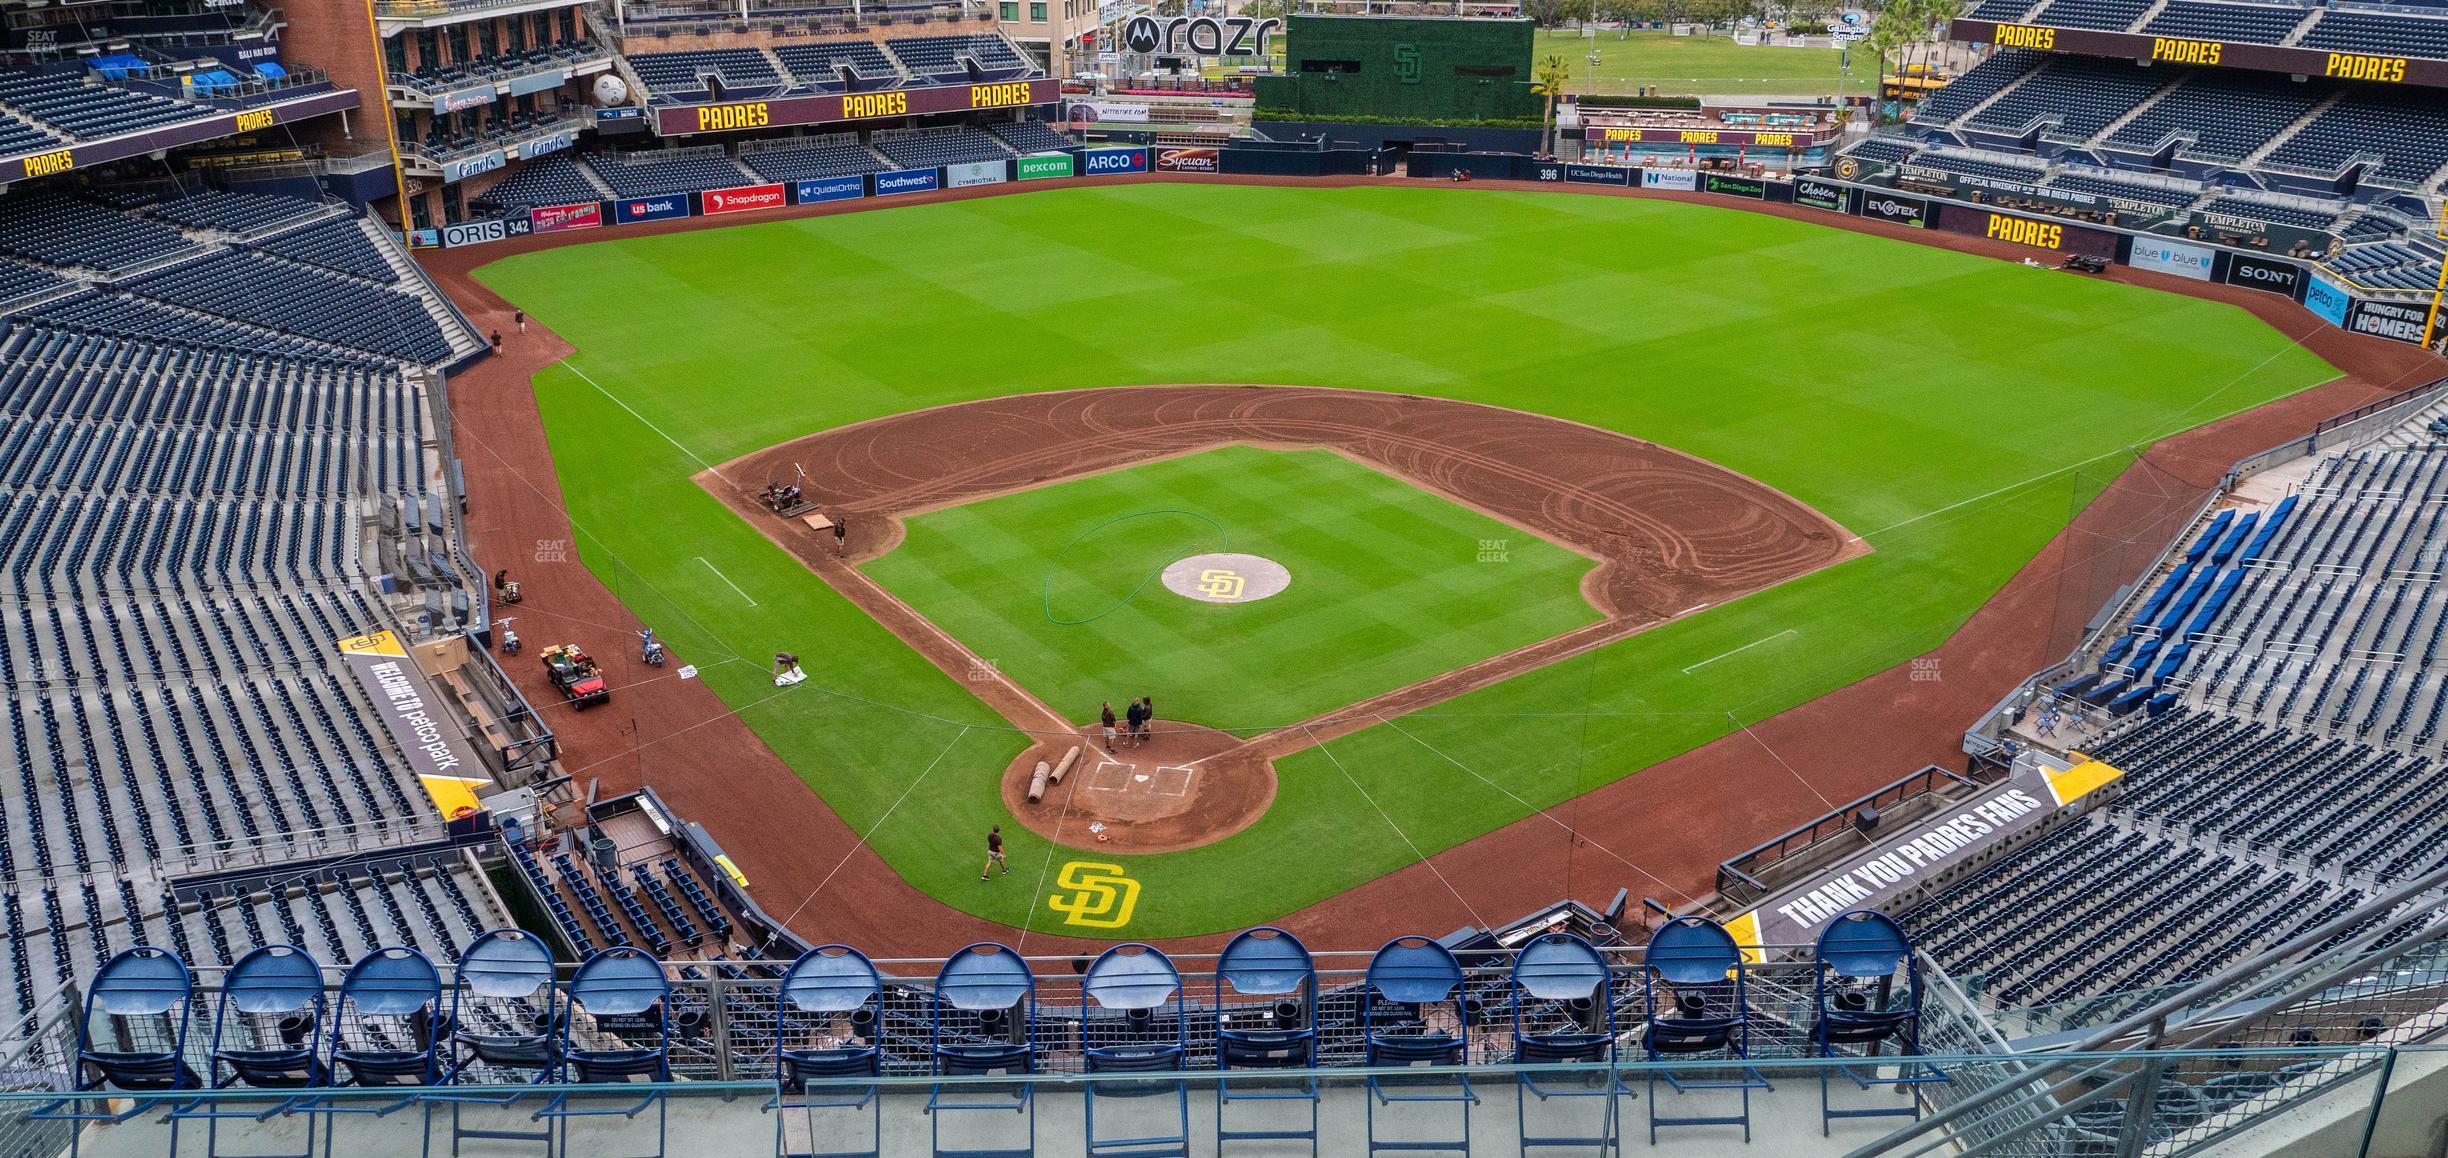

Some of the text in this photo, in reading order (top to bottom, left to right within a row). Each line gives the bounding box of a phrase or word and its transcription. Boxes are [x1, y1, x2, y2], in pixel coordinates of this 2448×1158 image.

[1165, 17, 1281, 56] razr
[1827, 24, 1871, 34] Gallagher
[1995, 25, 2054, 50] PADRES
[2152, 38, 2222, 65] PADRES
[2326, 53, 2406, 82] PADRES
[972, 82, 1031, 108] PADRES
[843, 92, 907, 118] PADRES
[236, 109, 273, 133] PADRES
[698, 103, 768, 131] PADRES
[1605, 129, 1641, 141] PADRES
[1680, 131, 1717, 143] PADRES
[1755, 133, 1792, 146] PADRES
[23, 150, 73, 177] PADRES
[1088, 155, 1130, 169] ARCO
[1160, 150, 1213, 170] Sycuan
[880, 175, 928, 189] Southwest
[957, 176, 997, 186] CYMBIOTIKA
[1540, 169, 1558, 180] 396
[1661, 173, 1693, 182] National
[1900, 165, 1949, 181] TEMPLETON
[813, 183, 860, 195] QuidelOrtho
[1732, 184, 1750, 192] Diego
[1799, 182, 1837, 198] Chosen
[1959, 176, 1989, 188] OFFICIAL
[1990, 179, 2021, 192] WHISKEY
[2037, 187, 2050, 197] SAN
[2051, 190, 2070, 200] DIEGO
[2070, 193, 2096, 204] PADRES
[632, 201, 673, 214] us bank
[726, 192, 780, 206] Snapdragon
[2107, 199, 2166, 217] TEMPLETON
[1868, 200, 1920, 218] EVOTEK
[509, 221, 529, 234] 342
[1987, 212, 2063, 250] PADRES
[2204, 214, 2267, 233] TEMPLETON
[447, 222, 503, 245] ORIS
[2134, 245, 2159, 258] blue
[2173, 252, 2198, 266] blue
[2239, 265, 2296, 286] SONY
[2309, 286, 2333, 308] petco
[2363, 302, 2425, 323] HUNGRY FOR
[2354, 313, 2426, 342] HOMERS
[1198, 569, 1245, 599] SD
[370, 661, 459, 771] WELCOME TO petco park
[1777, 789, 2042, 929] THANK YOU PADRES FANS
[1048, 861, 1141, 929] SD
